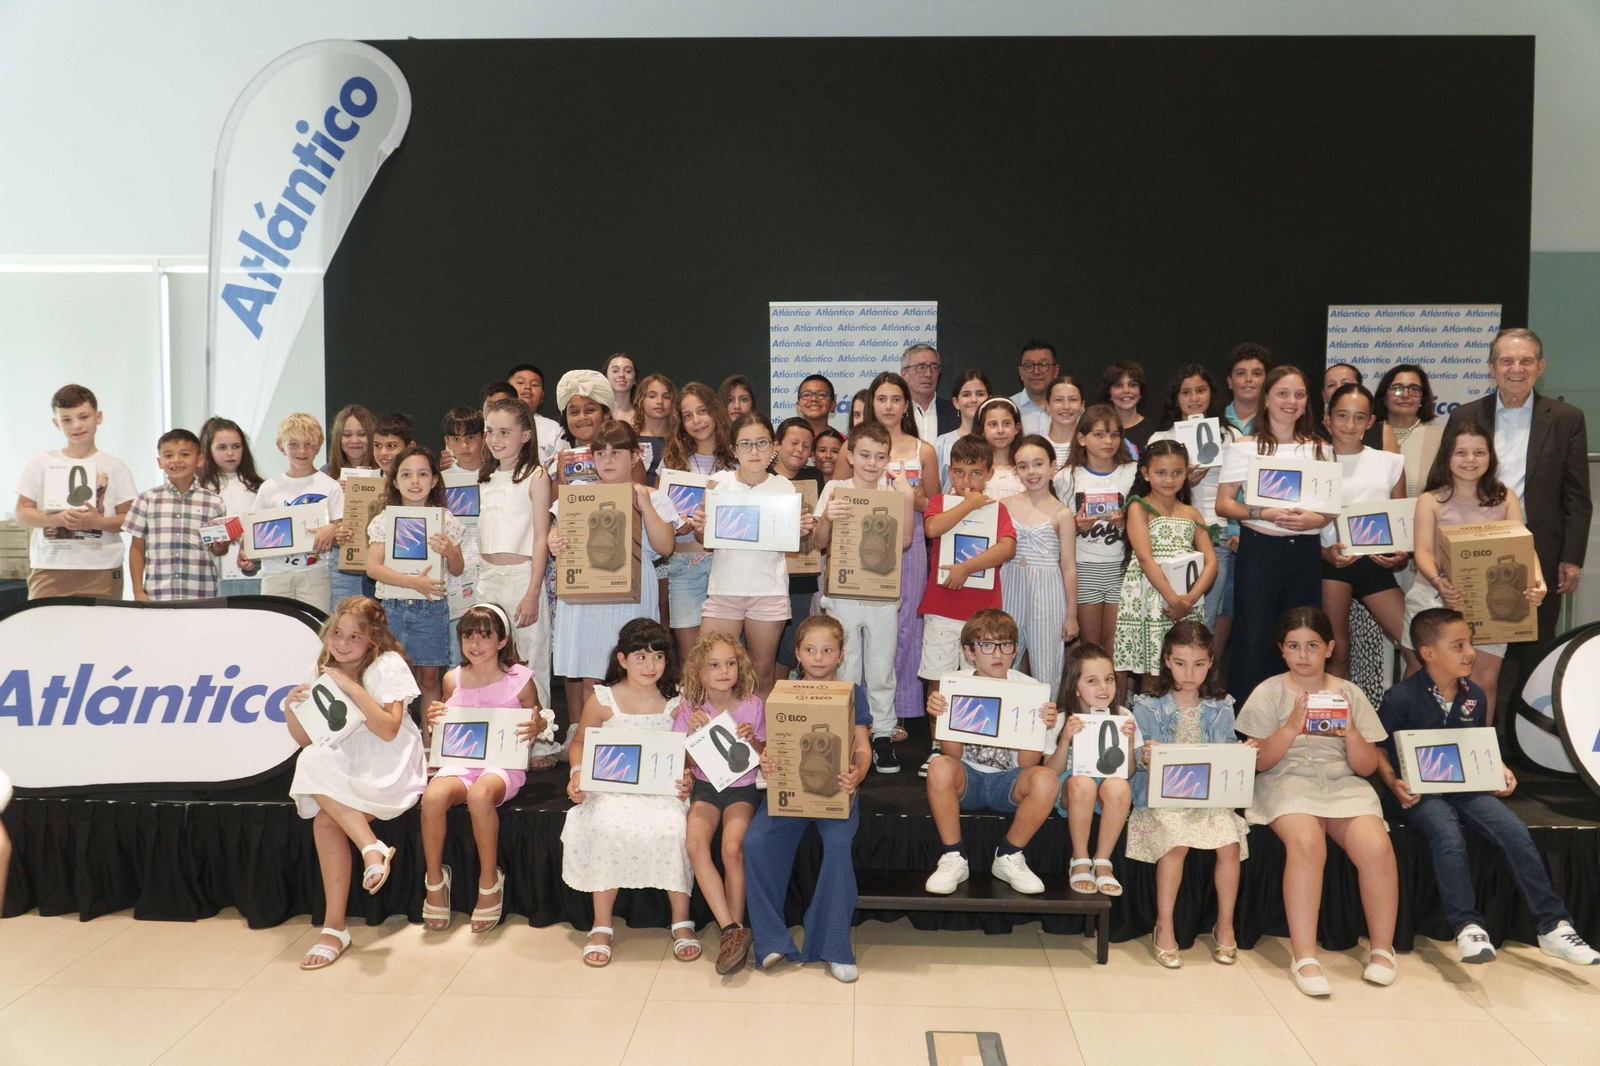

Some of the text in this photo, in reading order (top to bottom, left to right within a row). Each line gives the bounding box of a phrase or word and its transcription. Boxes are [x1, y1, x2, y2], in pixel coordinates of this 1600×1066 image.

[221, 76, 378, 340] Atlántico
[772, 308, 810, 316] Atlántico
[816, 308, 854, 316] Atlántico
[903, 308, 937, 316] Atlántic
[772, 339, 810, 347] Atlántico
[773, 370, 811, 378] Atlántico
[0, 664, 298, 726] Atlántico
[690, 736, 706, 748] SONY
